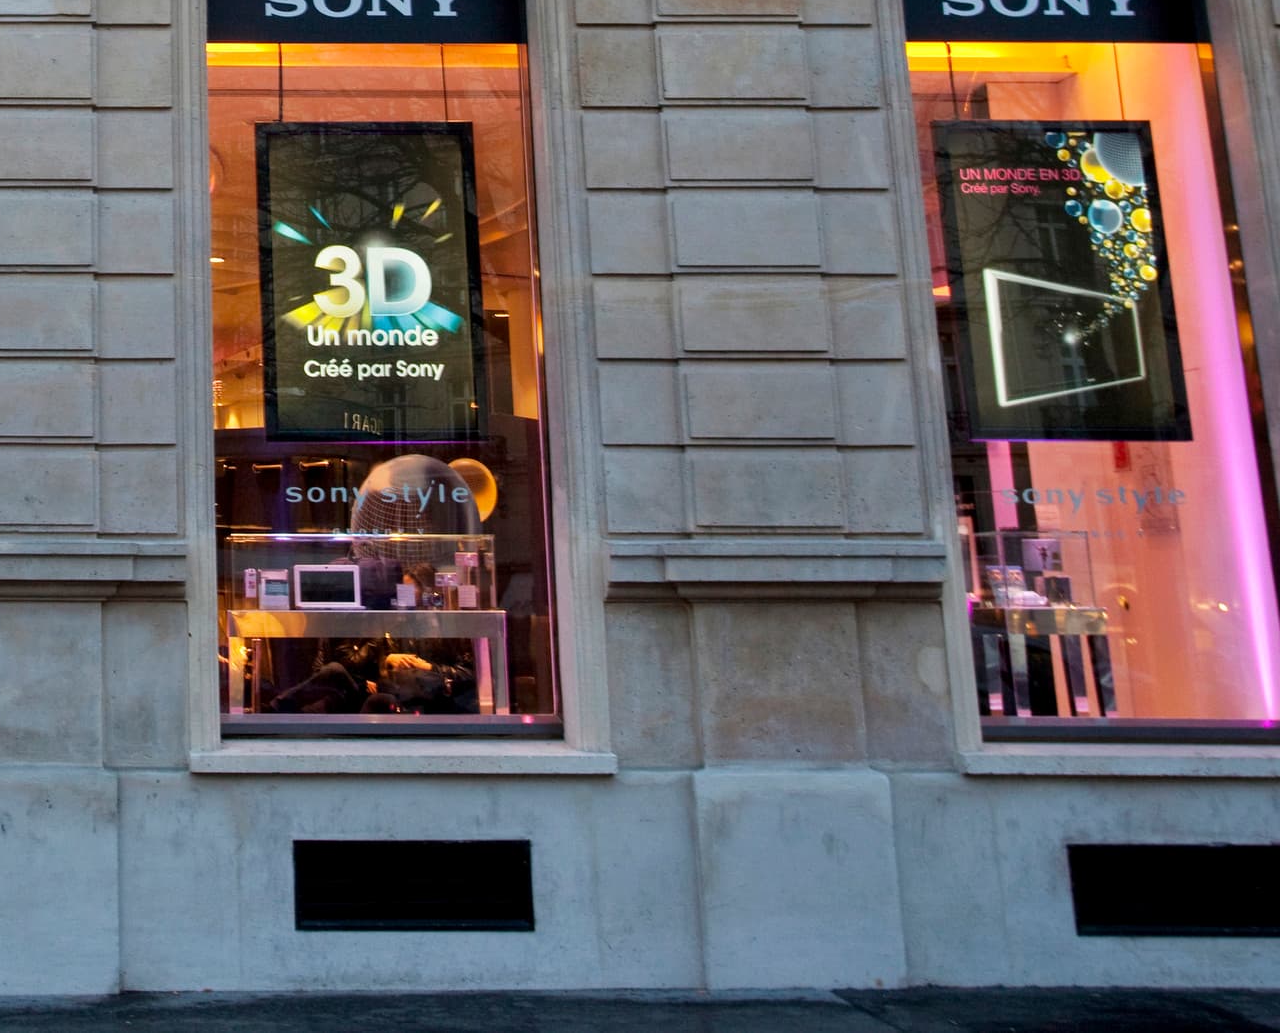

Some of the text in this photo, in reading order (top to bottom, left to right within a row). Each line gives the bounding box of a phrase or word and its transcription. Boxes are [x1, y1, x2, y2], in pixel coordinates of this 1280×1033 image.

[959, 168, 981, 181] UN
[983, 168, 1037, 181] MONDE
[1039, 168, 1059, 181] EN
[960, 182, 989, 194] Créé
[990, 184, 1009, 195] par
[313, 245, 432, 318] 3D
[306, 324, 439, 348] Un monde
[303, 358, 445, 381] Créé par Sony
[285, 481, 471, 513] sony style
[1001, 487, 1086, 512] sony
[1095, 486, 1188, 513] style
